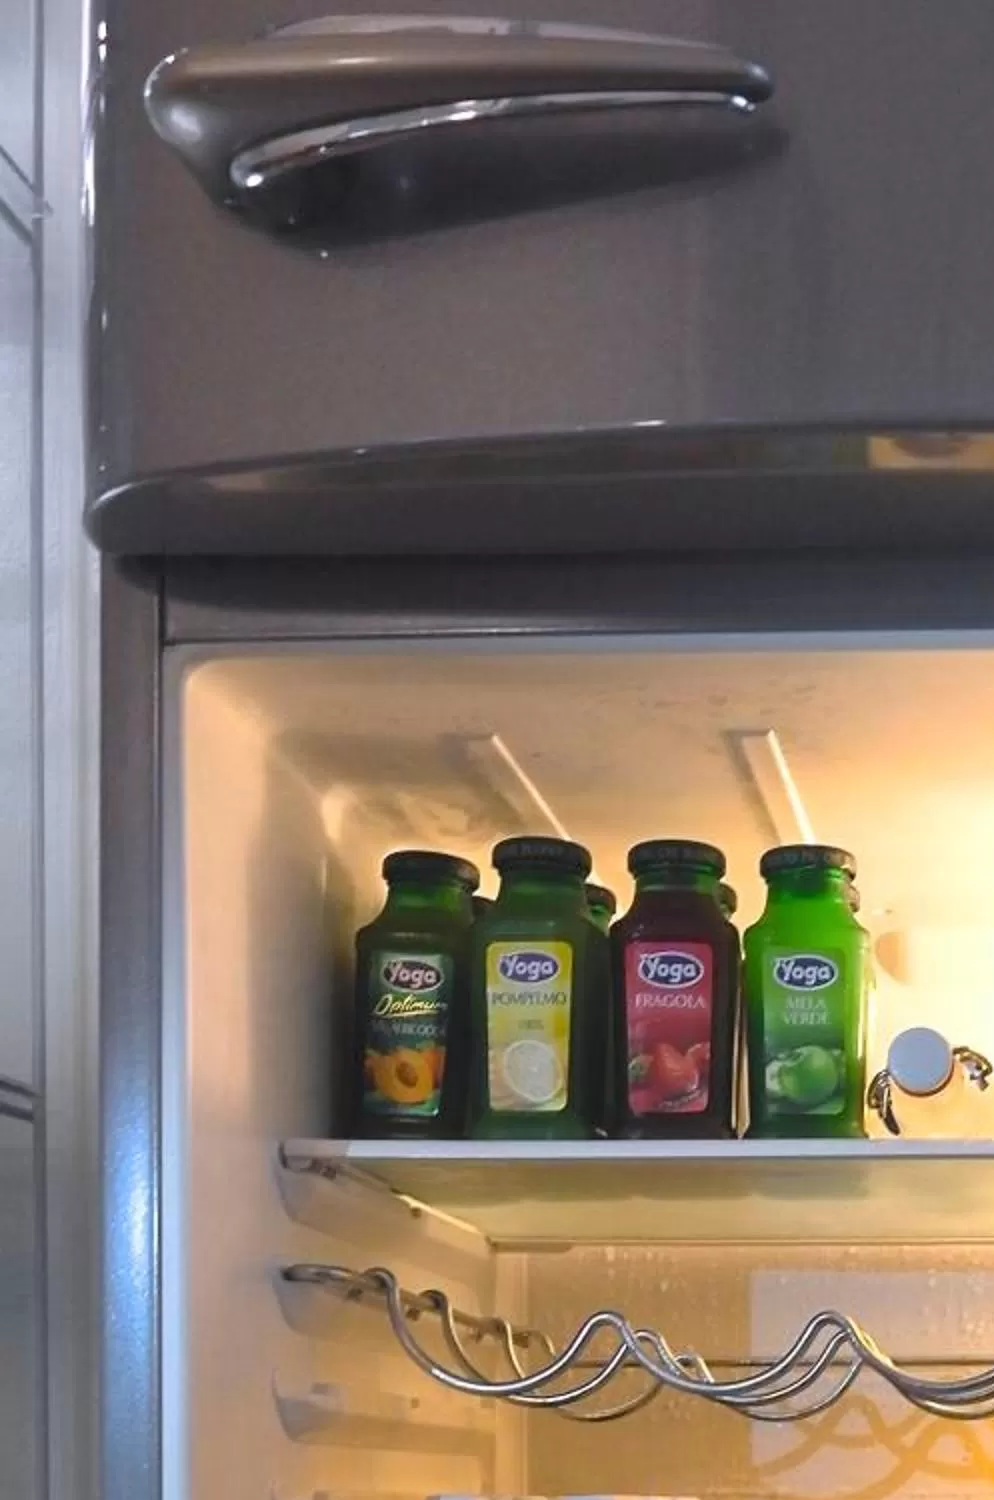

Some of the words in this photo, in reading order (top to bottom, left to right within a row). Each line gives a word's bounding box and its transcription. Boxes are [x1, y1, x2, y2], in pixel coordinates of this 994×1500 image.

[388, 960, 437, 988] Yoga
[504, 955, 554, 980] Yoga
[646, 957, 697, 983] Yoga
[781, 960, 831, 985] Yoga
[492, 991, 567, 1006] POMPELMO
[635, 994, 706, 1009] FRAGOLA
